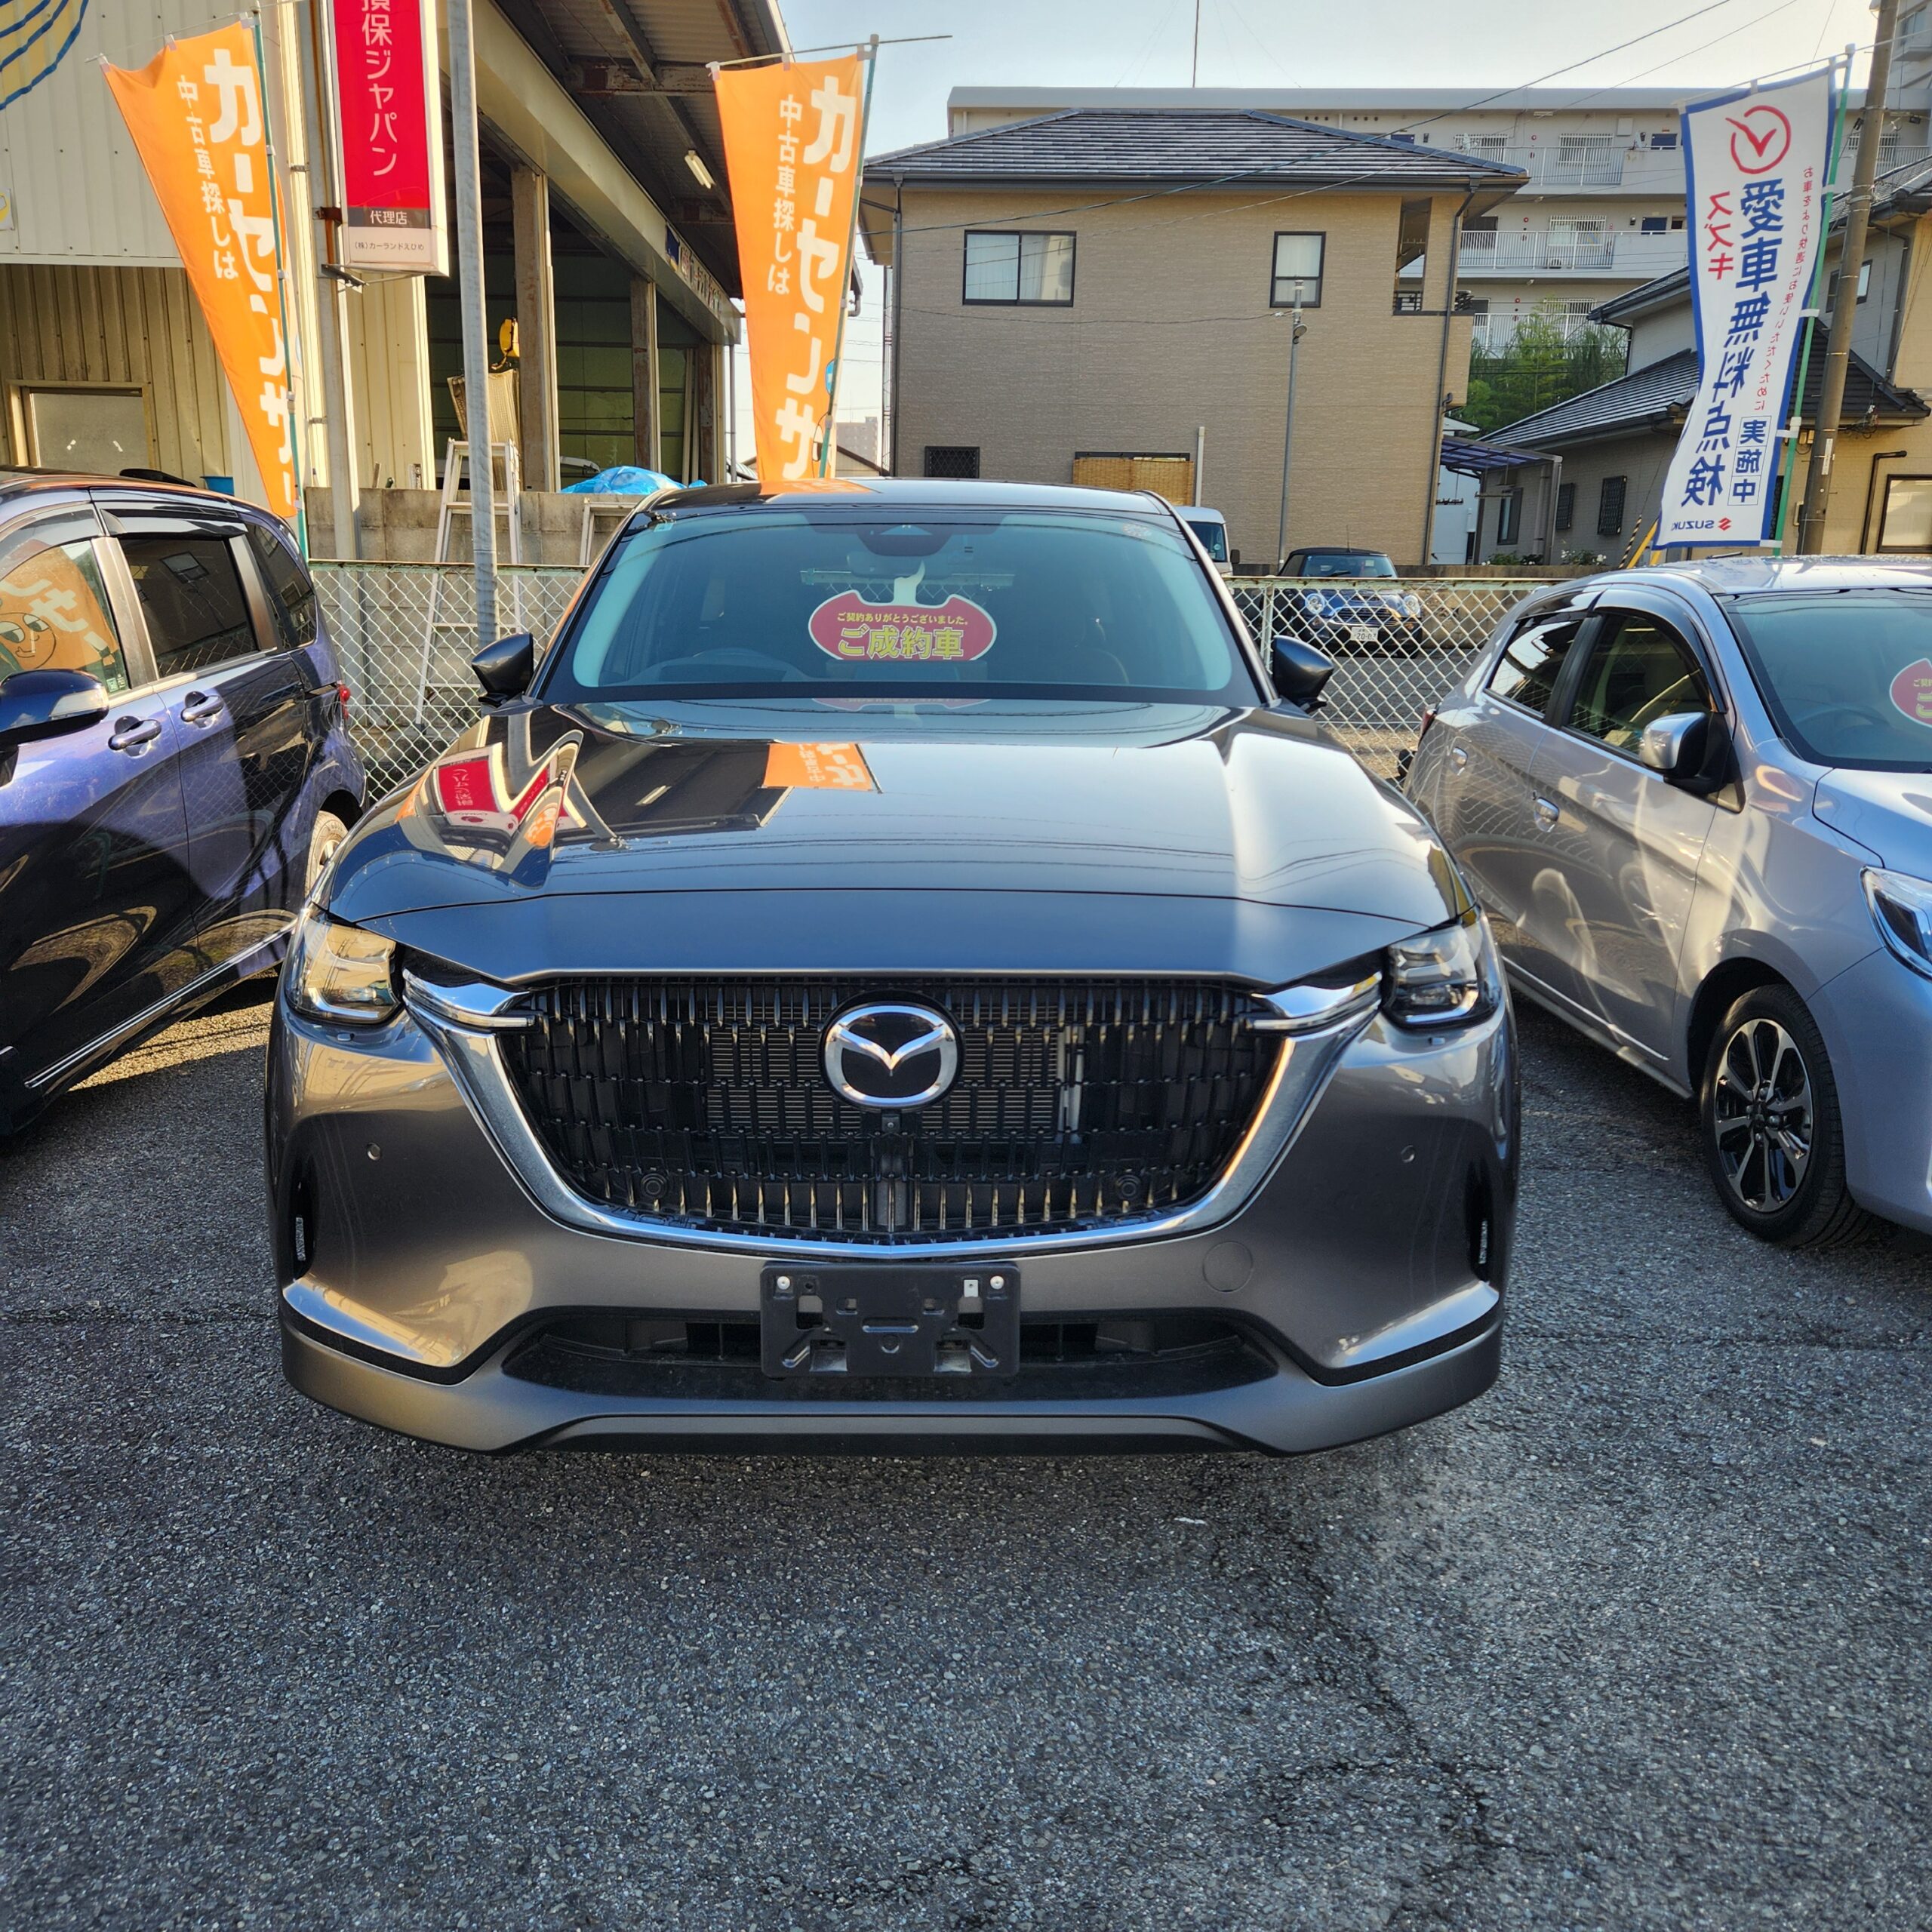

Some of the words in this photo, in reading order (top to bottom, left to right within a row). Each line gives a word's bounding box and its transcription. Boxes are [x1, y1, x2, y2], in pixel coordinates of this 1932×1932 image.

[177, 74, 239, 280] 中古車探しは
[205, 48, 292, 506] カーセンサー
[370, 210, 408, 225] 代理店
[767, 94, 803, 295] 中古車探しは
[775, 75, 857, 481] カーセンサ
[838, 624, 964, 660] ご成約車
